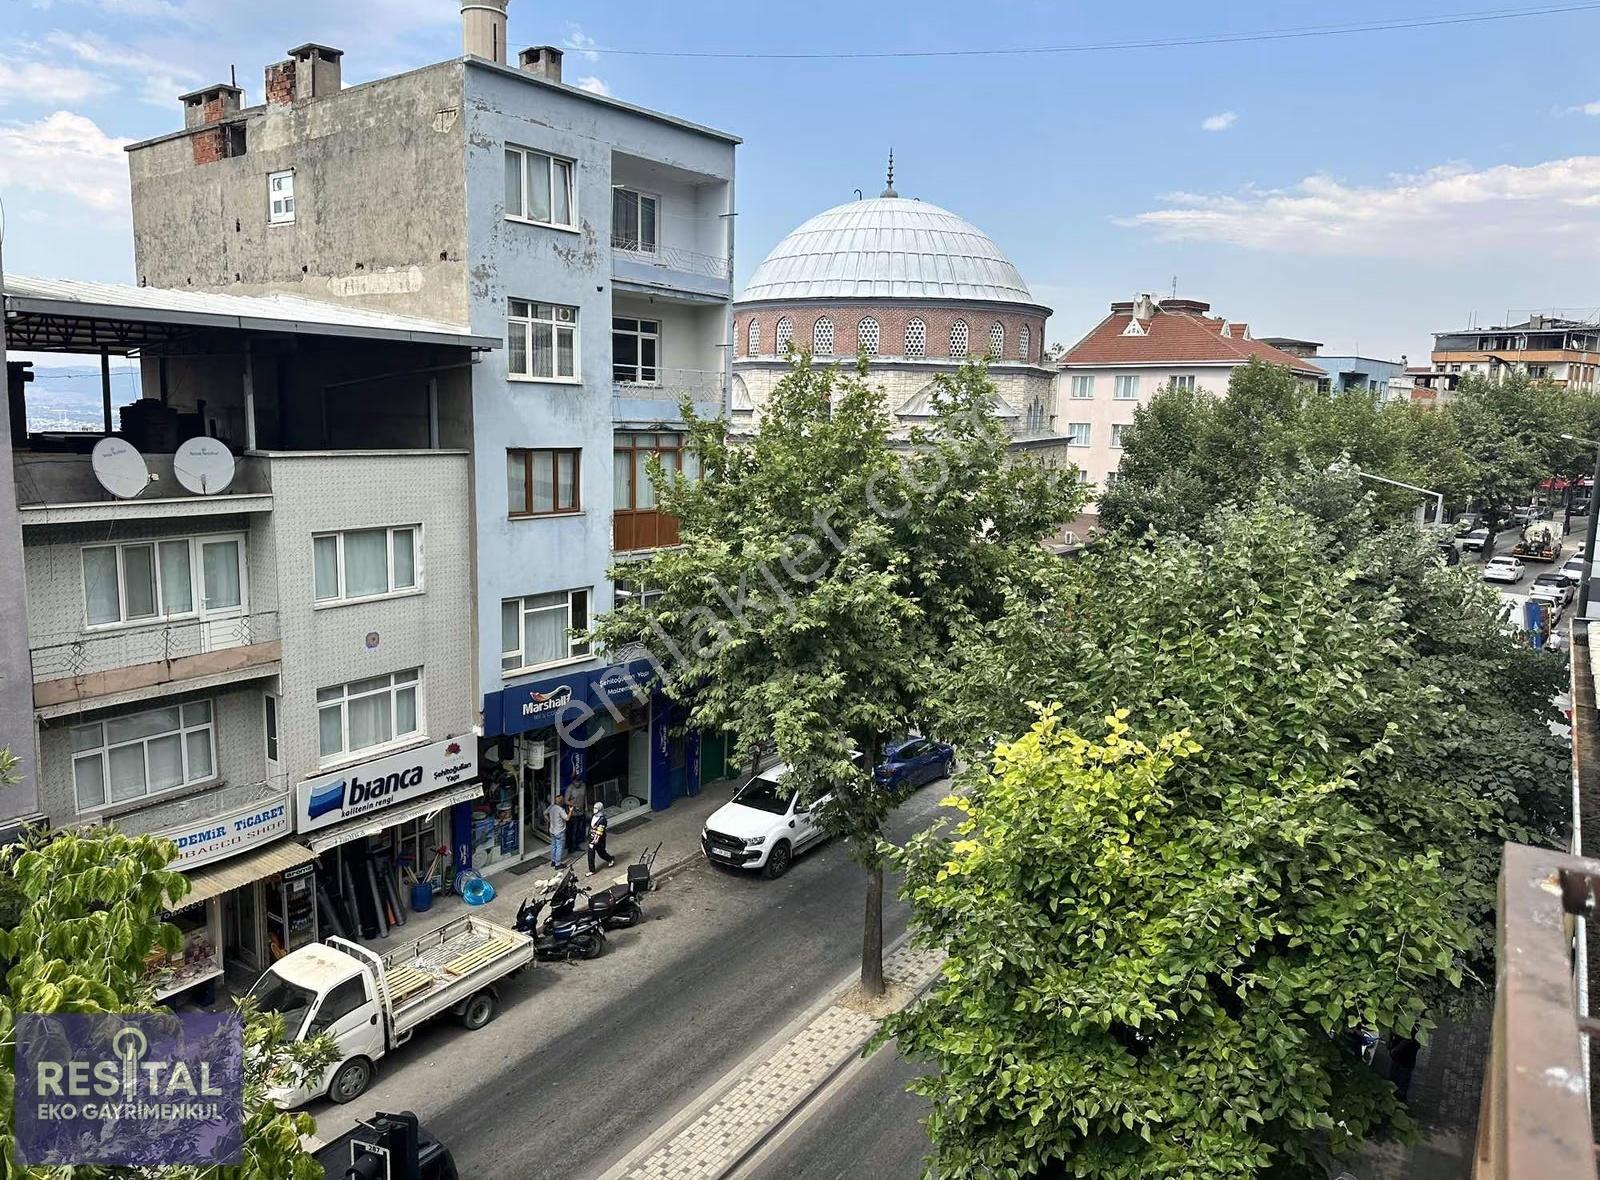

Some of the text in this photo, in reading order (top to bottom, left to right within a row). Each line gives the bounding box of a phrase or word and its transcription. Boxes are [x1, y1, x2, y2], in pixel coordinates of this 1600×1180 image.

[522, 695, 568, 716] Marshall
[349, 765, 423, 806] bianca
[341, 802, 374, 818] kalitenin
[375, 795, 394, 810] rengi
[247, 819, 285, 839] SHOP
[286, 865, 313, 878] aroma
